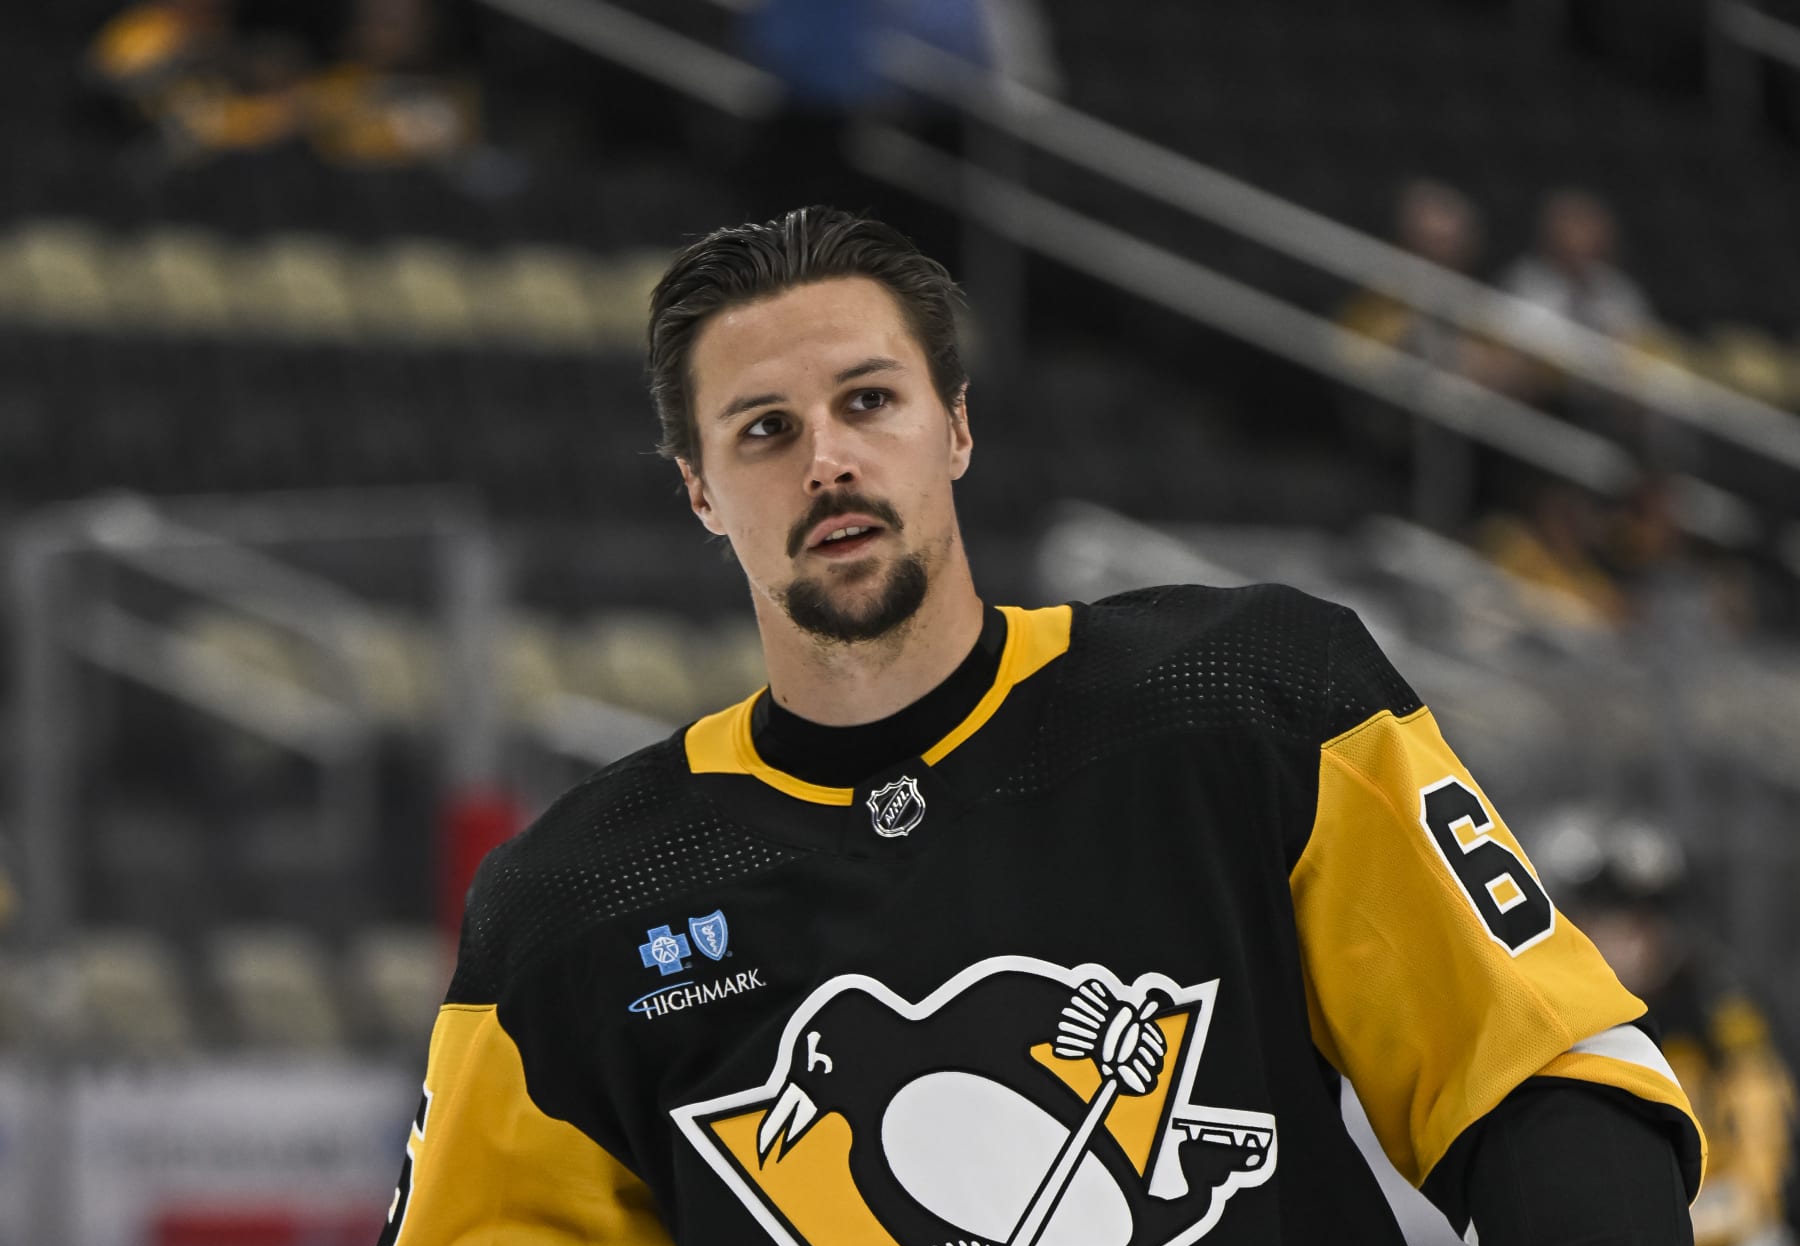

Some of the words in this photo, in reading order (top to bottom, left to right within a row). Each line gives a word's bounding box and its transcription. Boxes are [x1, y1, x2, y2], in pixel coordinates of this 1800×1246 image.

[885, 790, 910, 826] NHL
[1419, 774, 1556, 958] 6
[642, 968, 763, 1019] HIGHMARK
